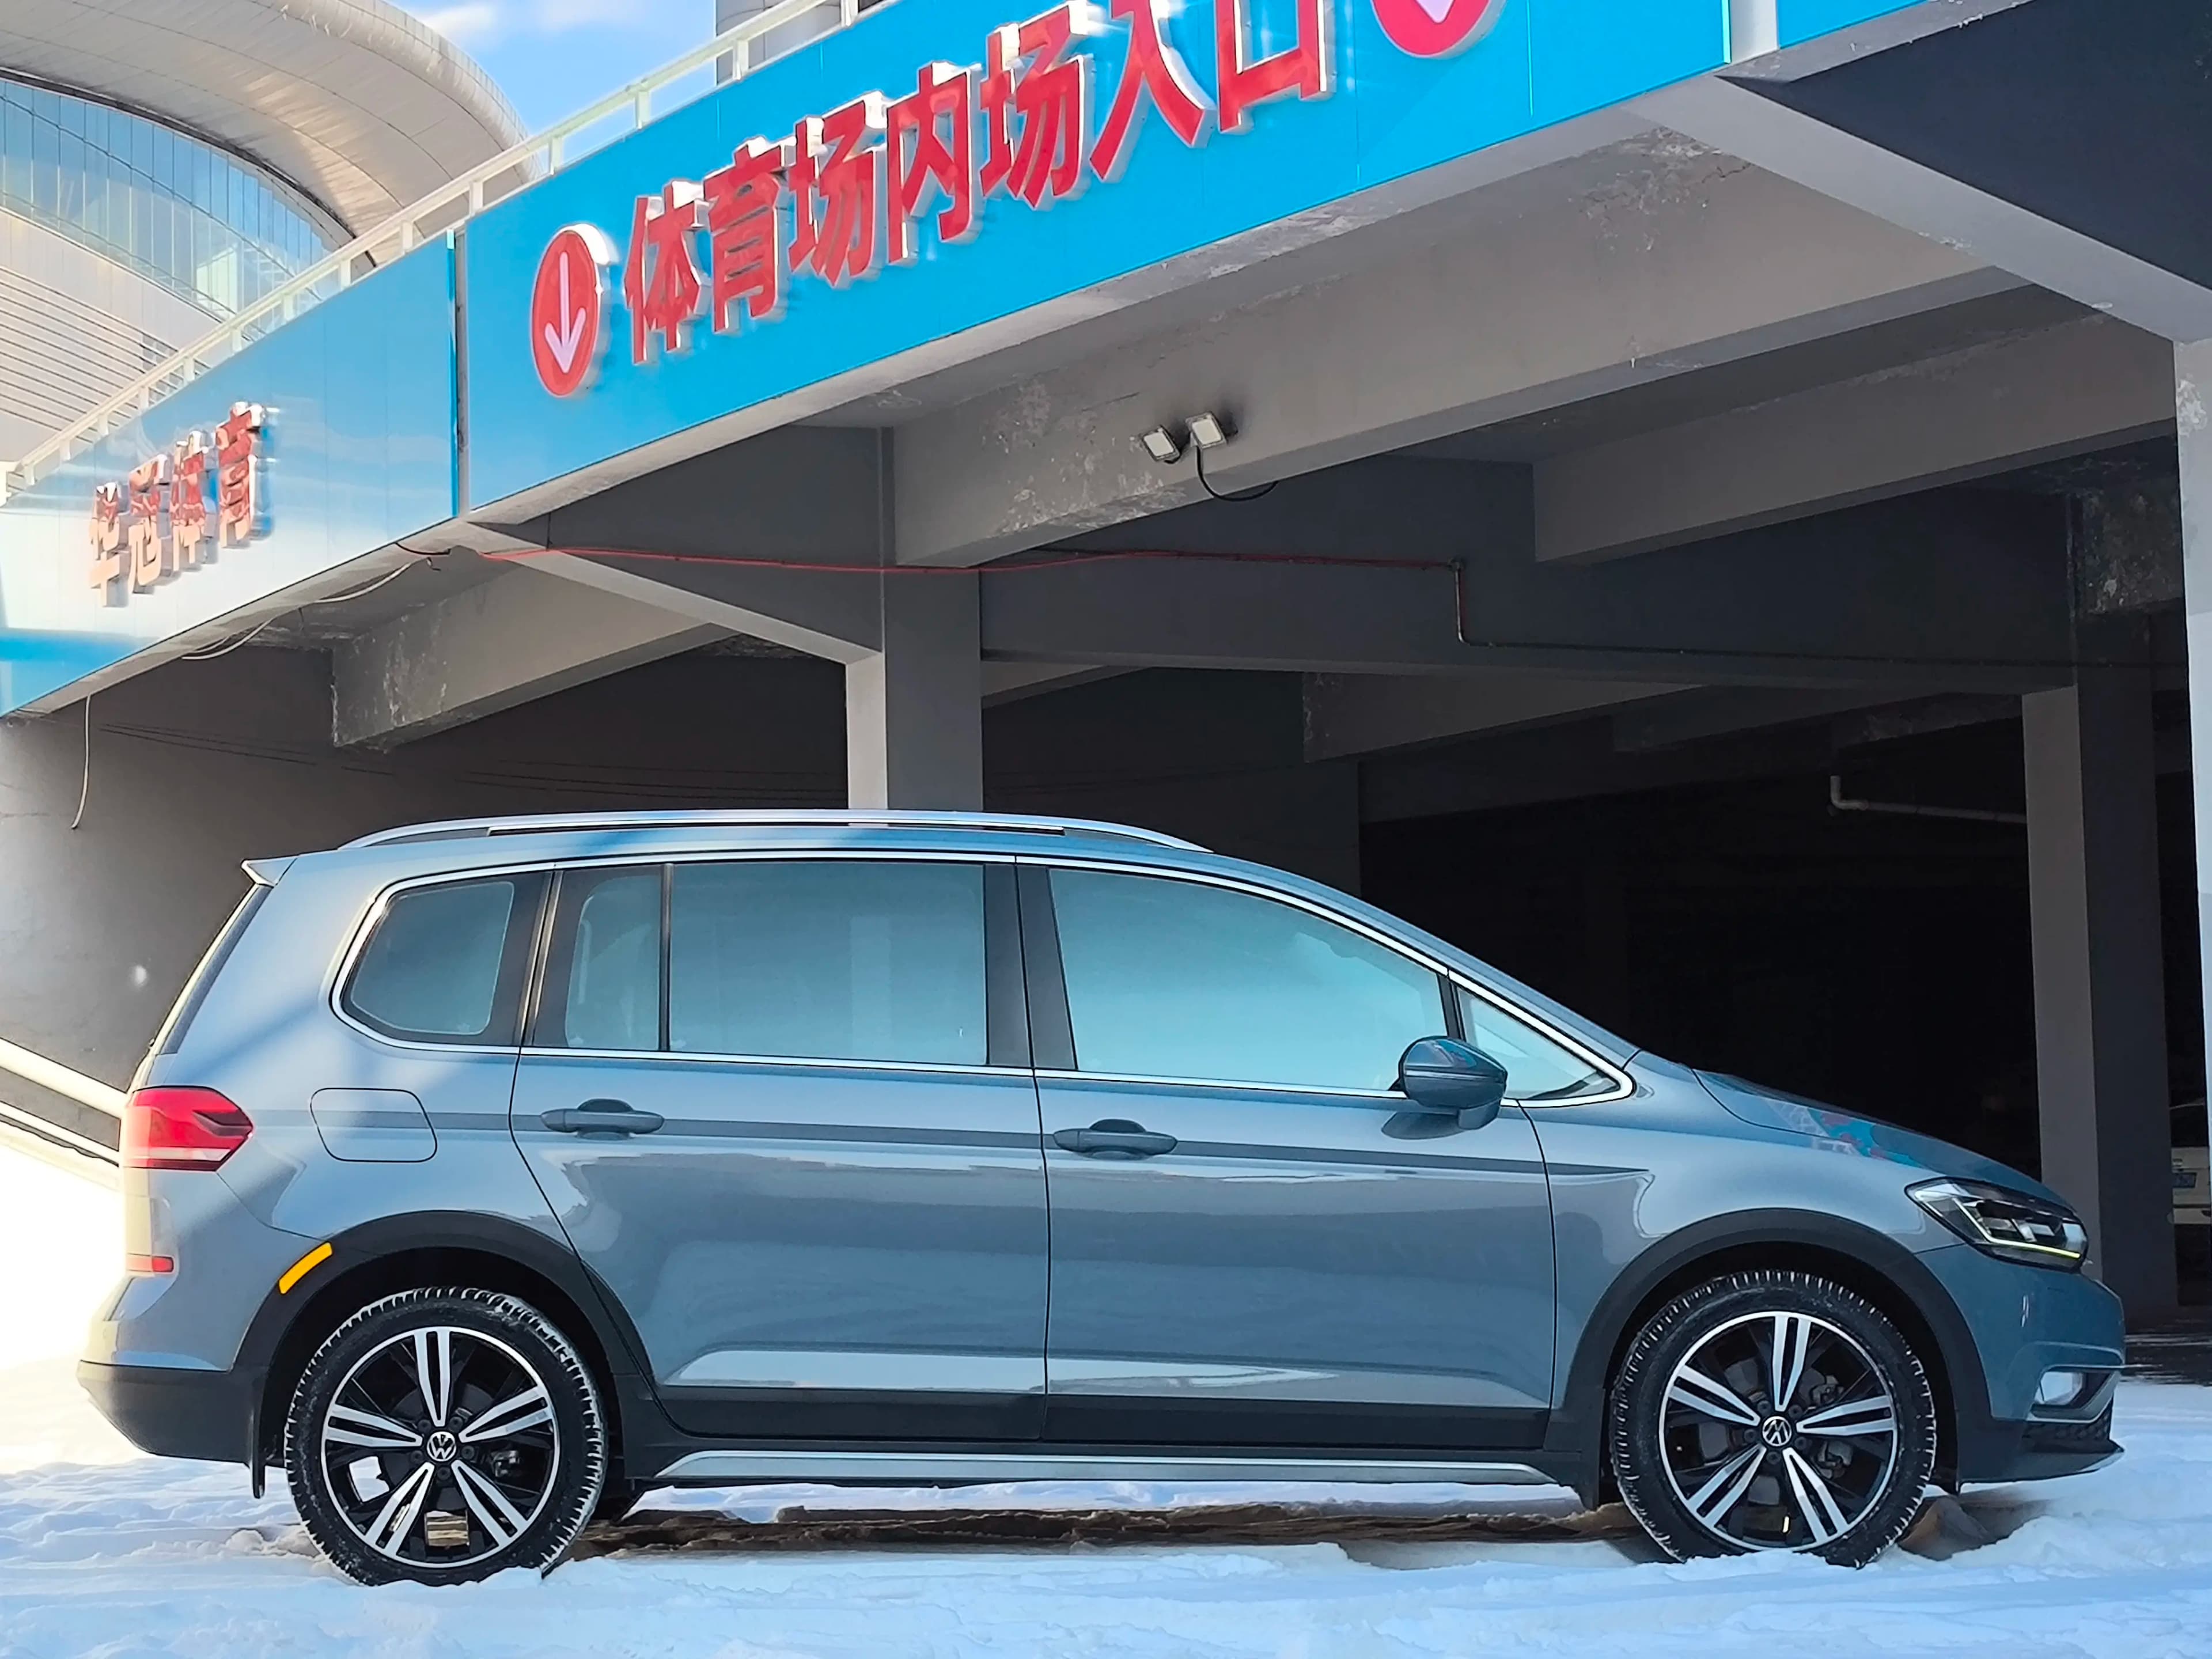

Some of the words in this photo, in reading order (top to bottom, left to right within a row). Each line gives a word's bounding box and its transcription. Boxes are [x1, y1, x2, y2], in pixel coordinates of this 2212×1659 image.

[623, 0, 1328, 364] 体育场内场入口
